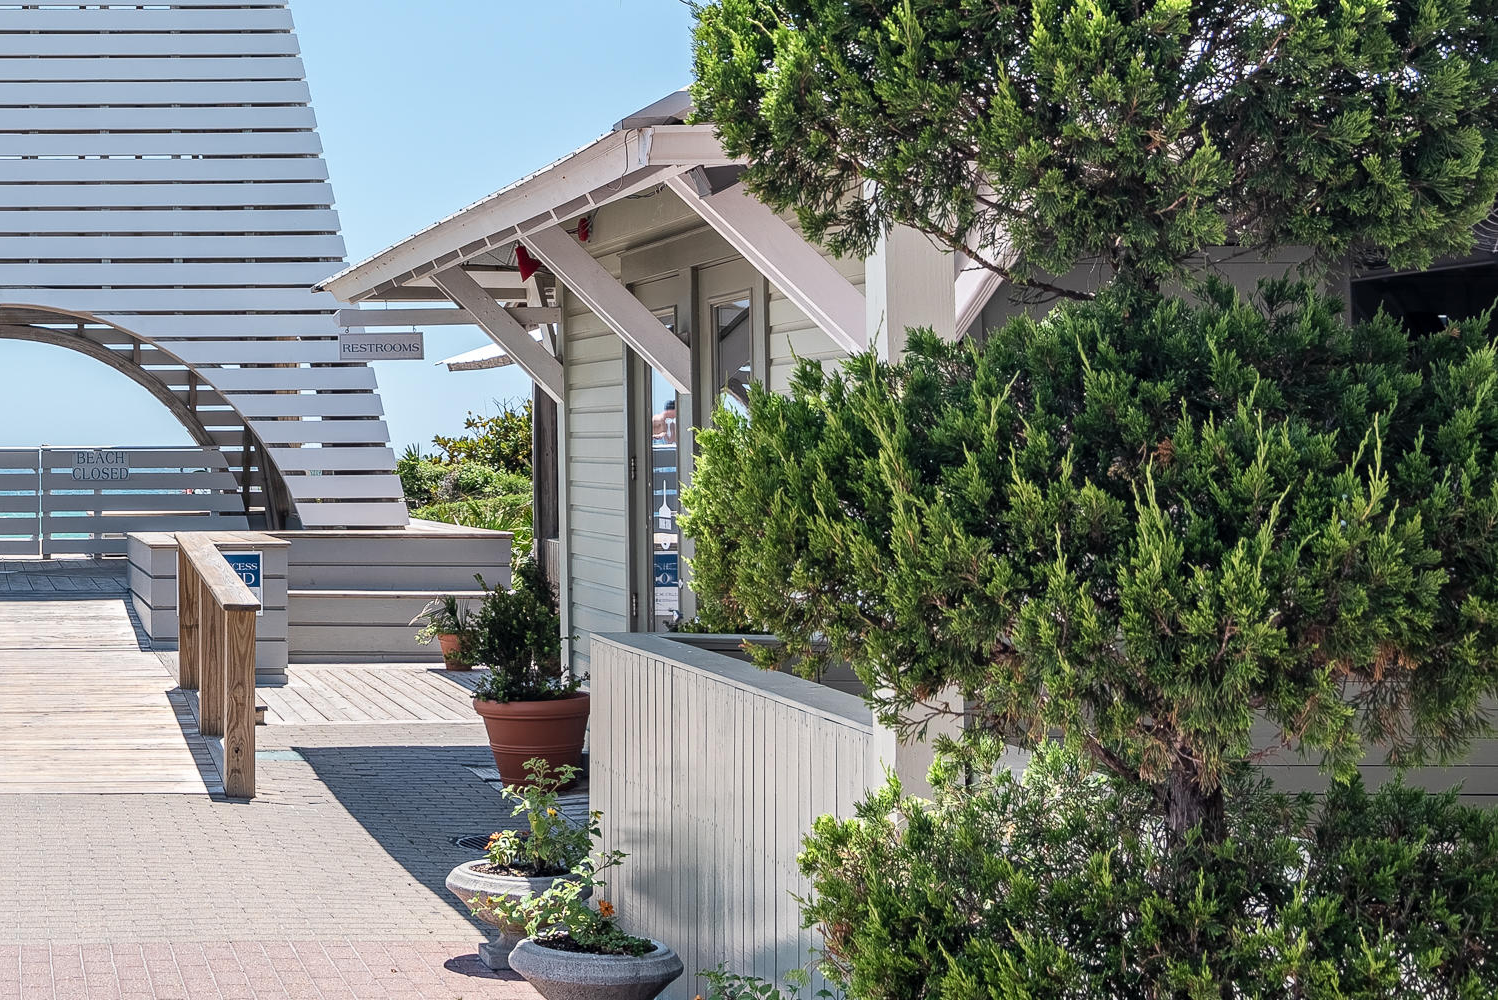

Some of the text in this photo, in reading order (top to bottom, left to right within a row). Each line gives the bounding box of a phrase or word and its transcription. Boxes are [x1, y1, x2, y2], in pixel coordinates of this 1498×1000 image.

[342, 343, 420, 353] RESTROOMS
[77, 451, 124, 464] BEACH
[72, 468, 129, 480] CLOSED
[230, 562, 258, 571] CESS
